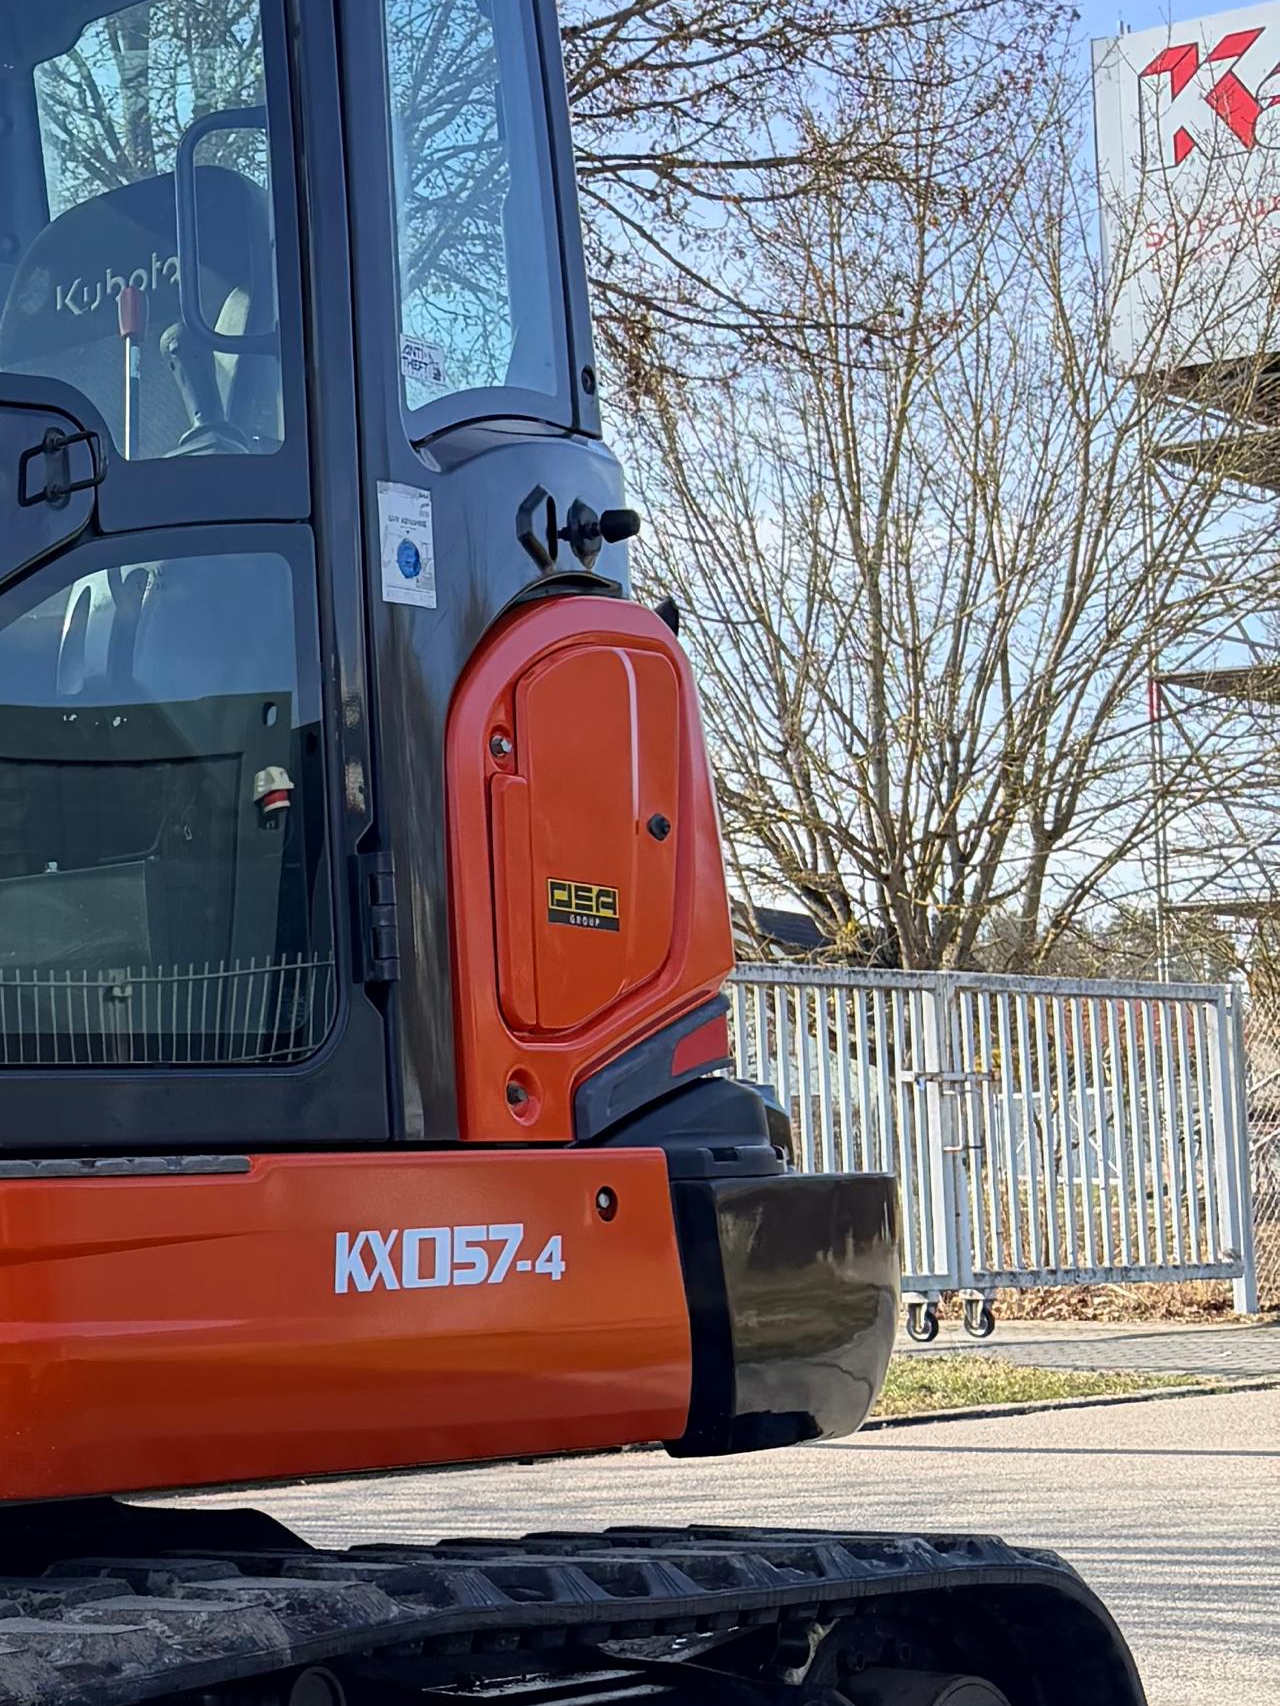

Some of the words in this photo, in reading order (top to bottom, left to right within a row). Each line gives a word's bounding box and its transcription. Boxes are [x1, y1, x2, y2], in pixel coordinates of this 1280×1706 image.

[55, 251, 181, 317] Kubota
[569, 914, 600, 927] GROUP
[334, 1222, 566, 1294] KX057-4
